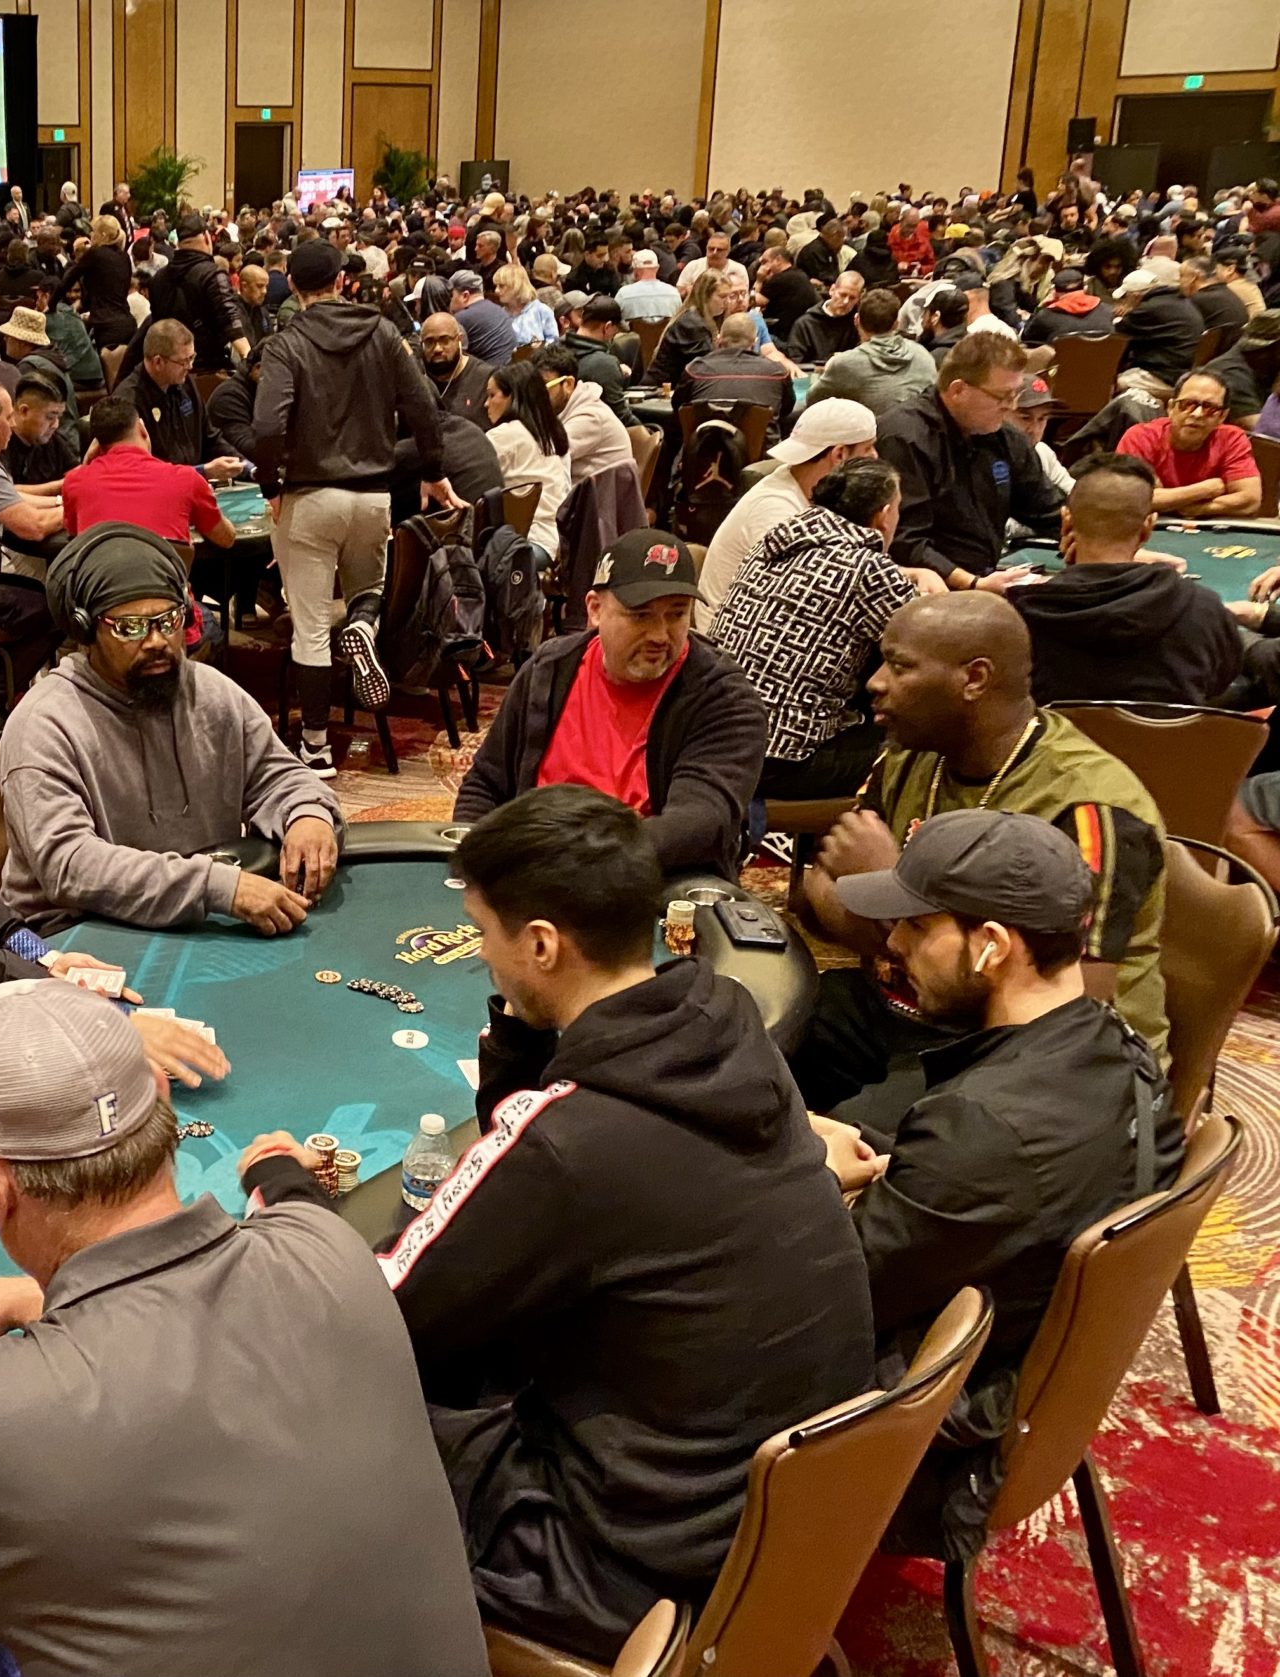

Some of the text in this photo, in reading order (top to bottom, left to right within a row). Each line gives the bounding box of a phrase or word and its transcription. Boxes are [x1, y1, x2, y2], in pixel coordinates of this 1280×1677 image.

[395, 939, 446, 965] Hard
[432, 924, 482, 946] Rock
[94, 1090, 117, 1136] F
